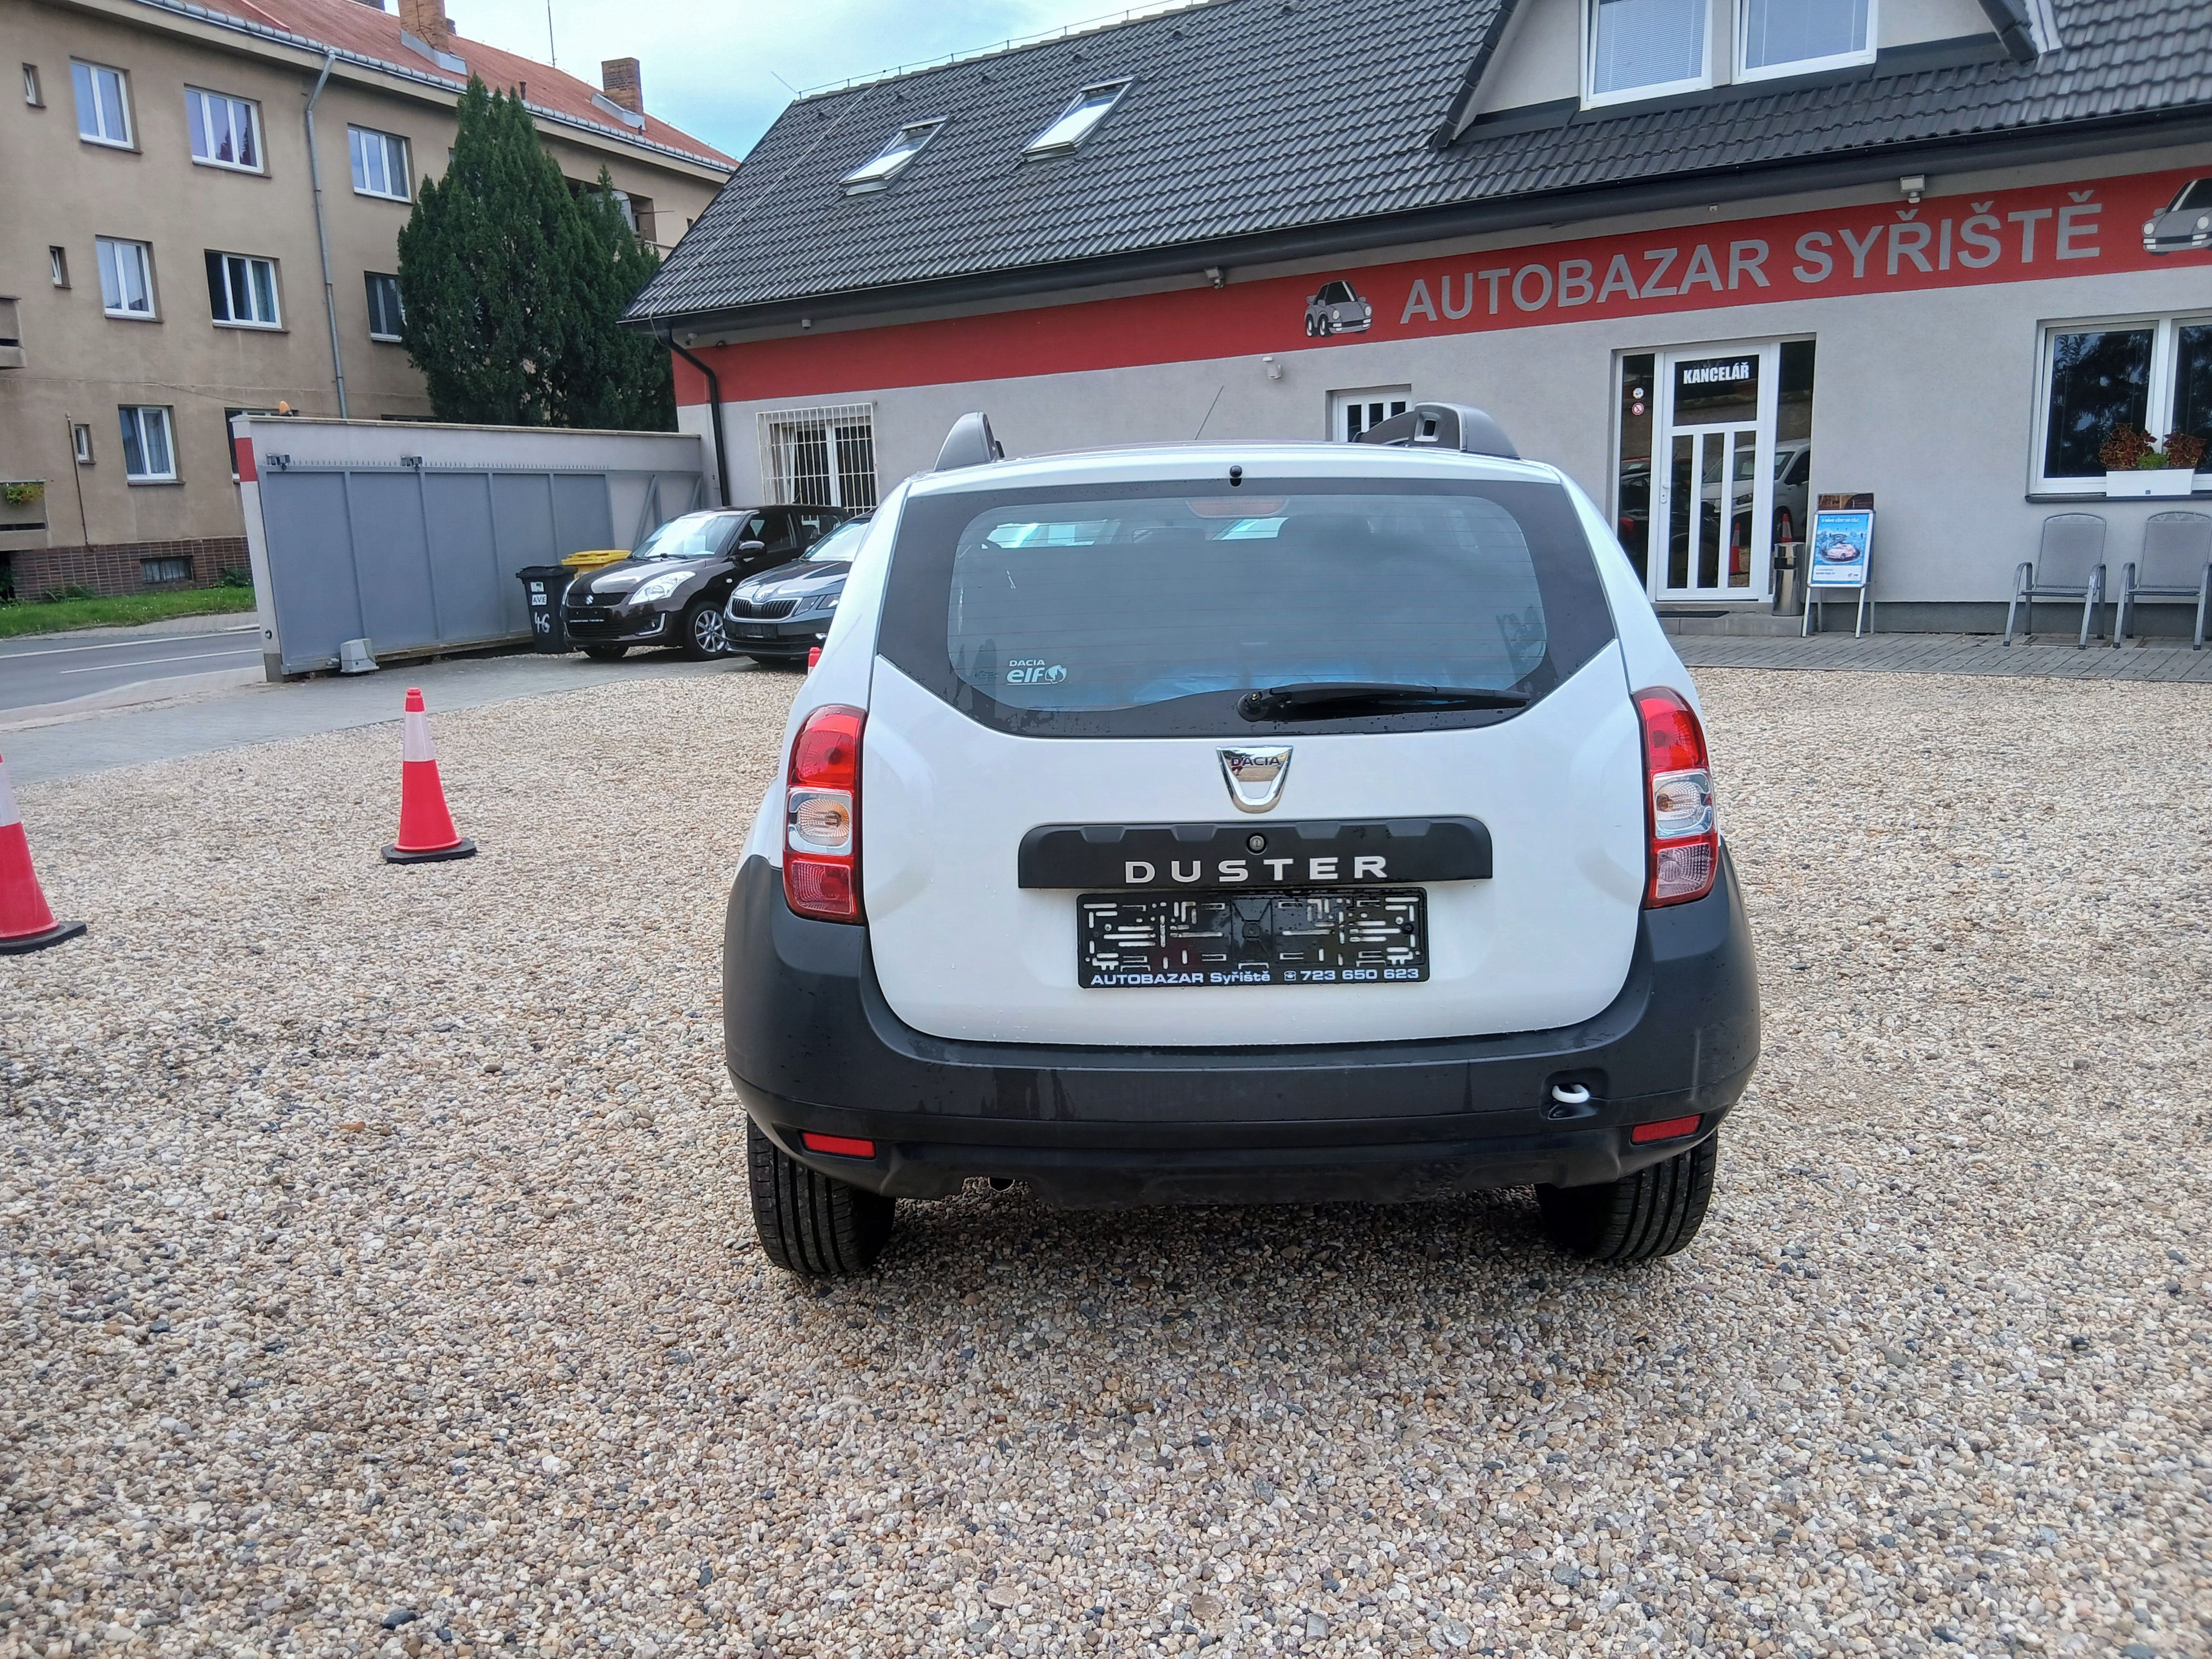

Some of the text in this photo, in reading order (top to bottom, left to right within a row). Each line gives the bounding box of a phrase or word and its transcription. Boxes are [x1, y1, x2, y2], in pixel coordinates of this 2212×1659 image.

[1399, 190, 2102, 324] AUTOBAZAR SYŘIŠTĚ
[1683, 362, 1750, 384] KANCELÁŘ
[1006, 667, 1045, 683] elf
[1231, 757, 1280, 766] DACIA
[1125, 856, 1388, 883] DUSTER
[1090, 968, 1419, 985] AUTOBAZAR Syřiště 723 650 623
